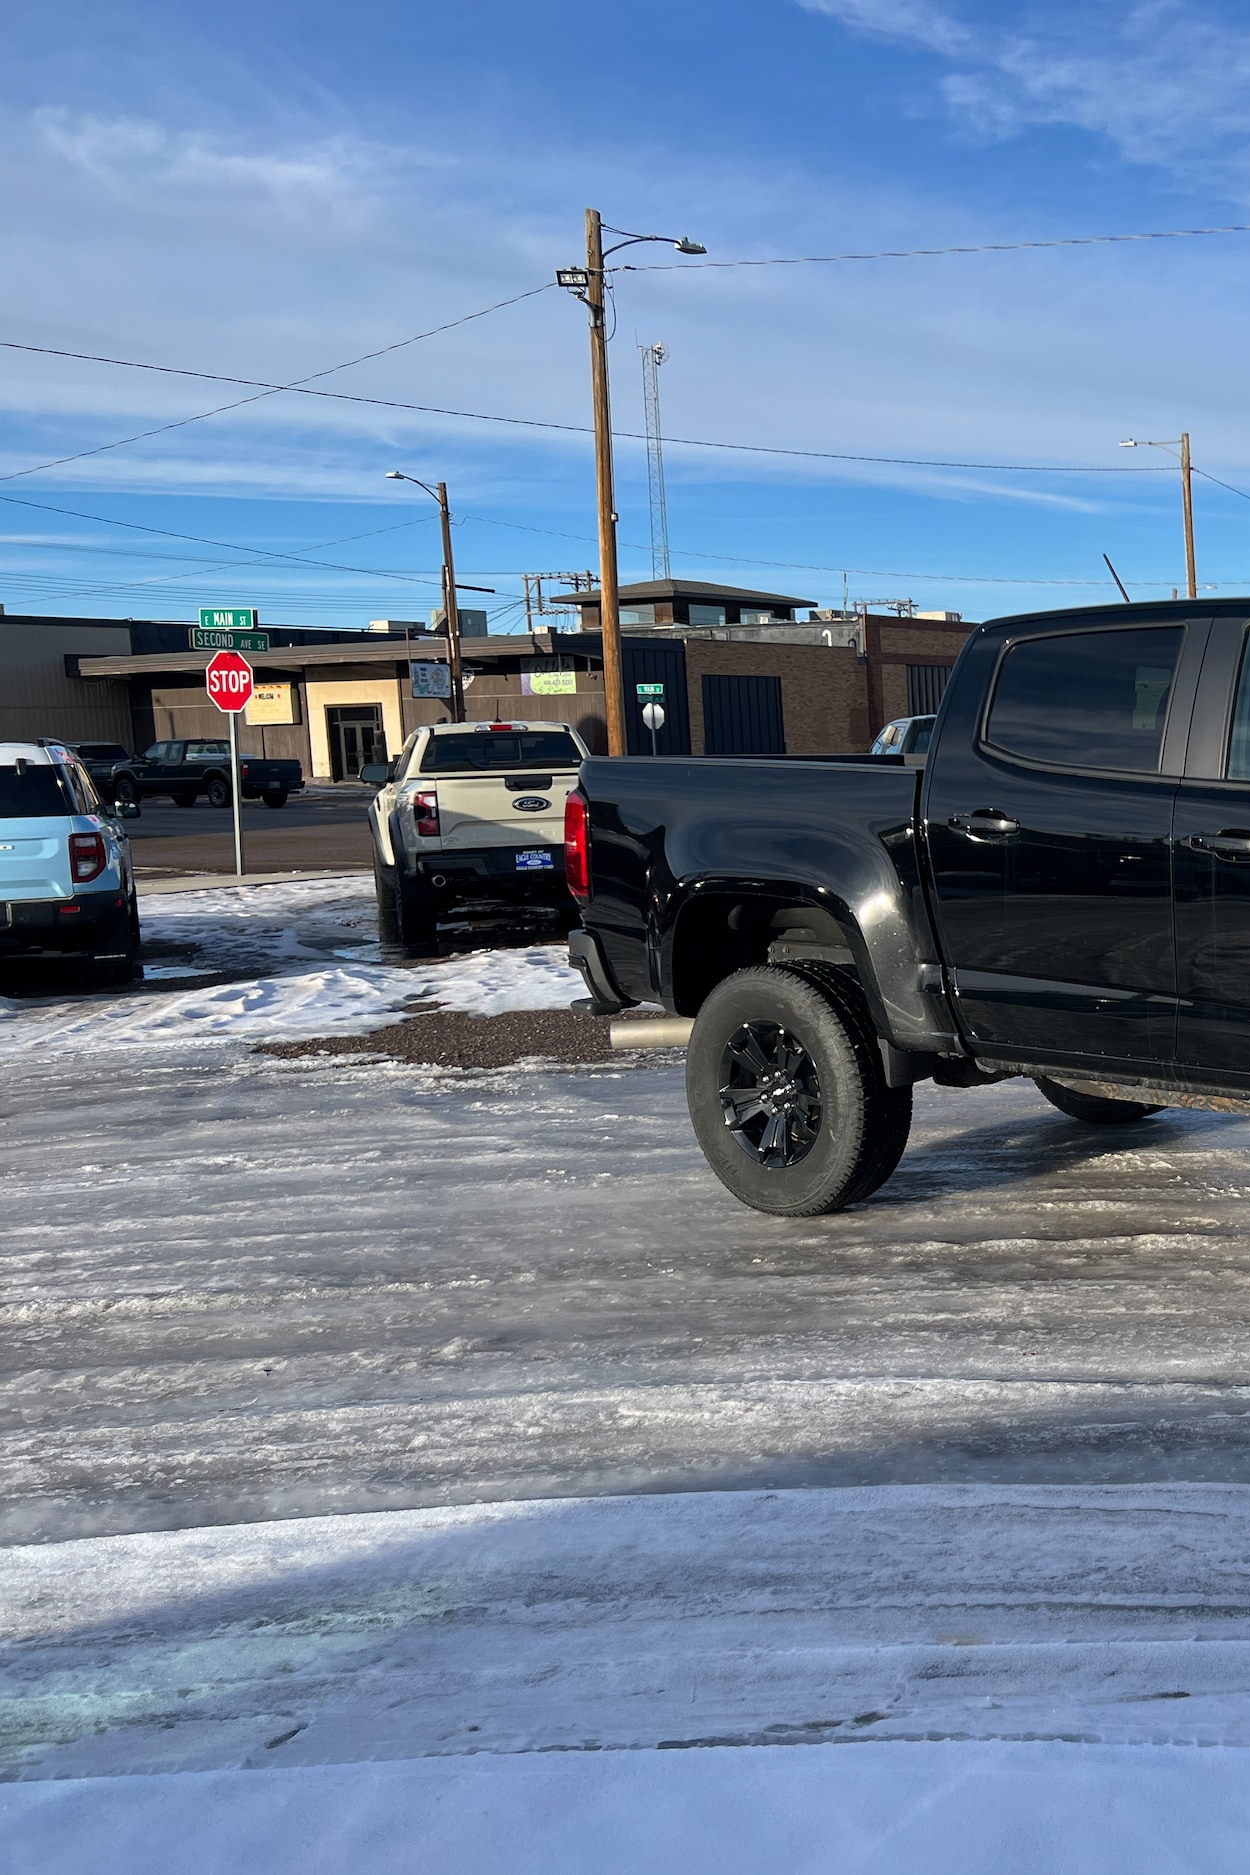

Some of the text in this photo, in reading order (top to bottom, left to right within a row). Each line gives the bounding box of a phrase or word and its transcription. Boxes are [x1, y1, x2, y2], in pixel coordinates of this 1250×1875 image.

[204, 612, 247, 626] E MAIN ST
[197, 631, 266, 651] SECOND AVE SE
[210, 670, 249, 693] STOP
